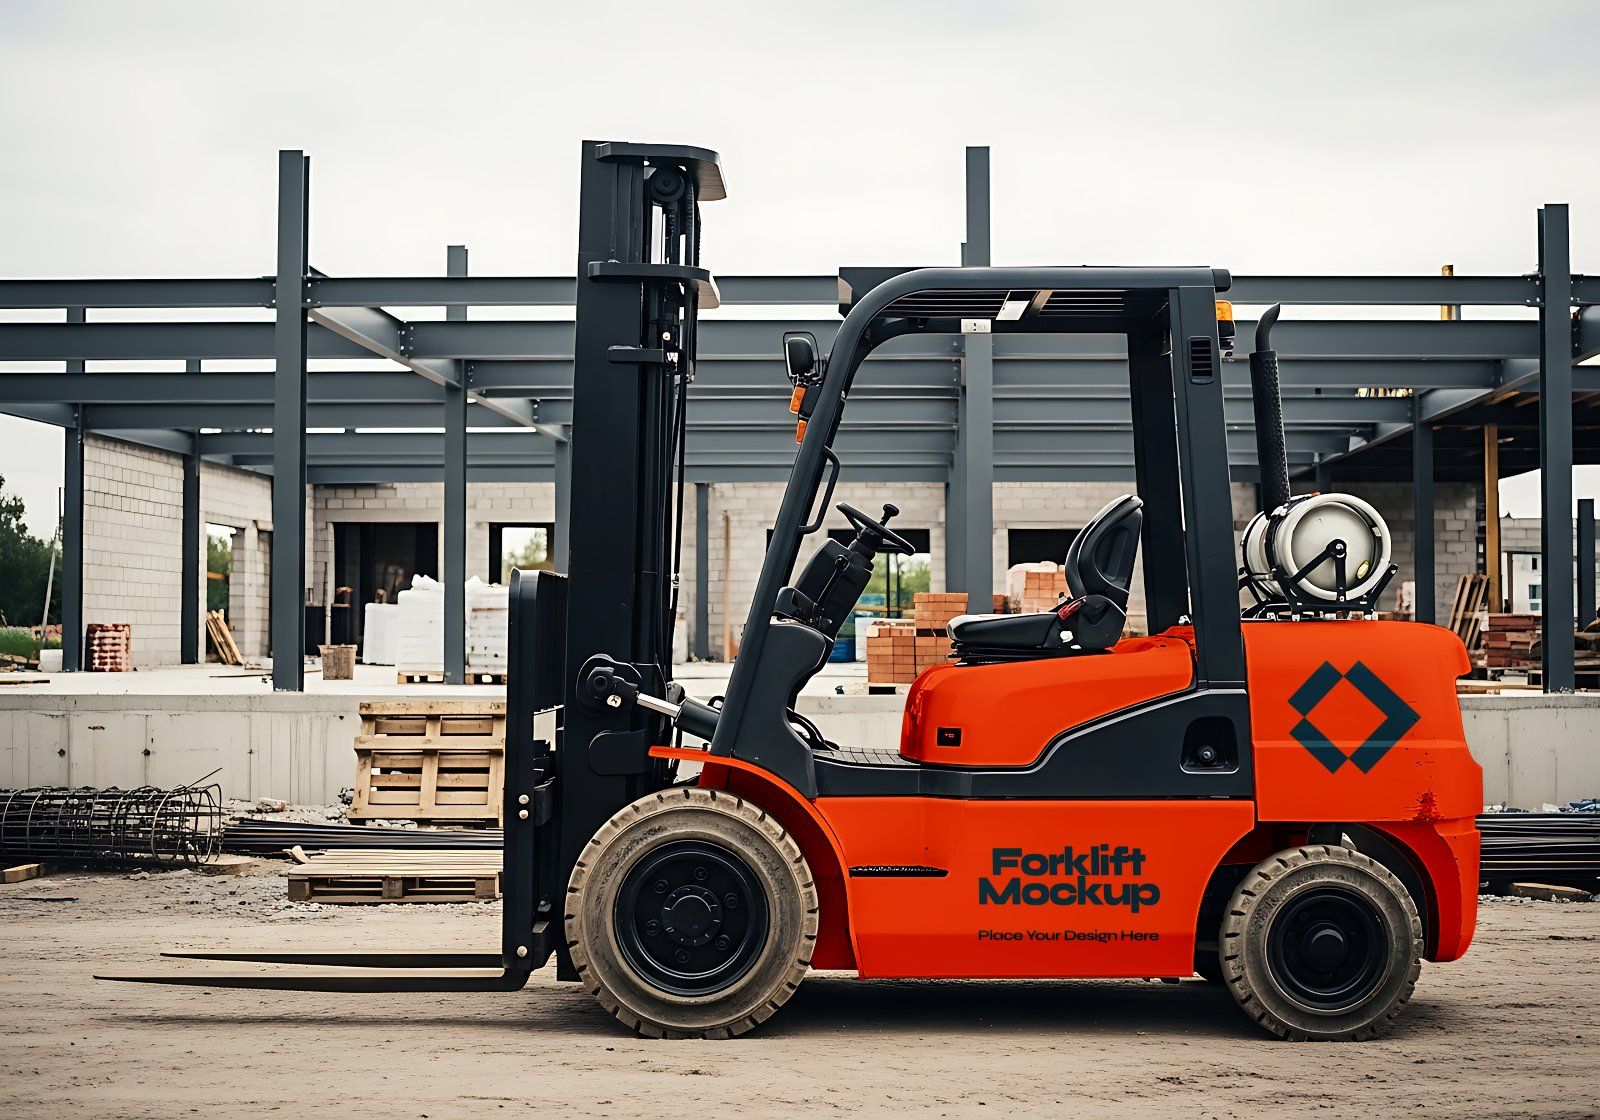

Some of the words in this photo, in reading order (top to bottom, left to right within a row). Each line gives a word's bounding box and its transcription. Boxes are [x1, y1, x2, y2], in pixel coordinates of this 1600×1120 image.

[992, 844, 1146, 876] Forklift
[978, 876, 1160, 913] Mockup
[978, 930, 1023, 941] Place
[1027, 930, 1060, 941] Your
[1064, 930, 1117, 944] Design
[1121, 930, 1159, 941] Here
